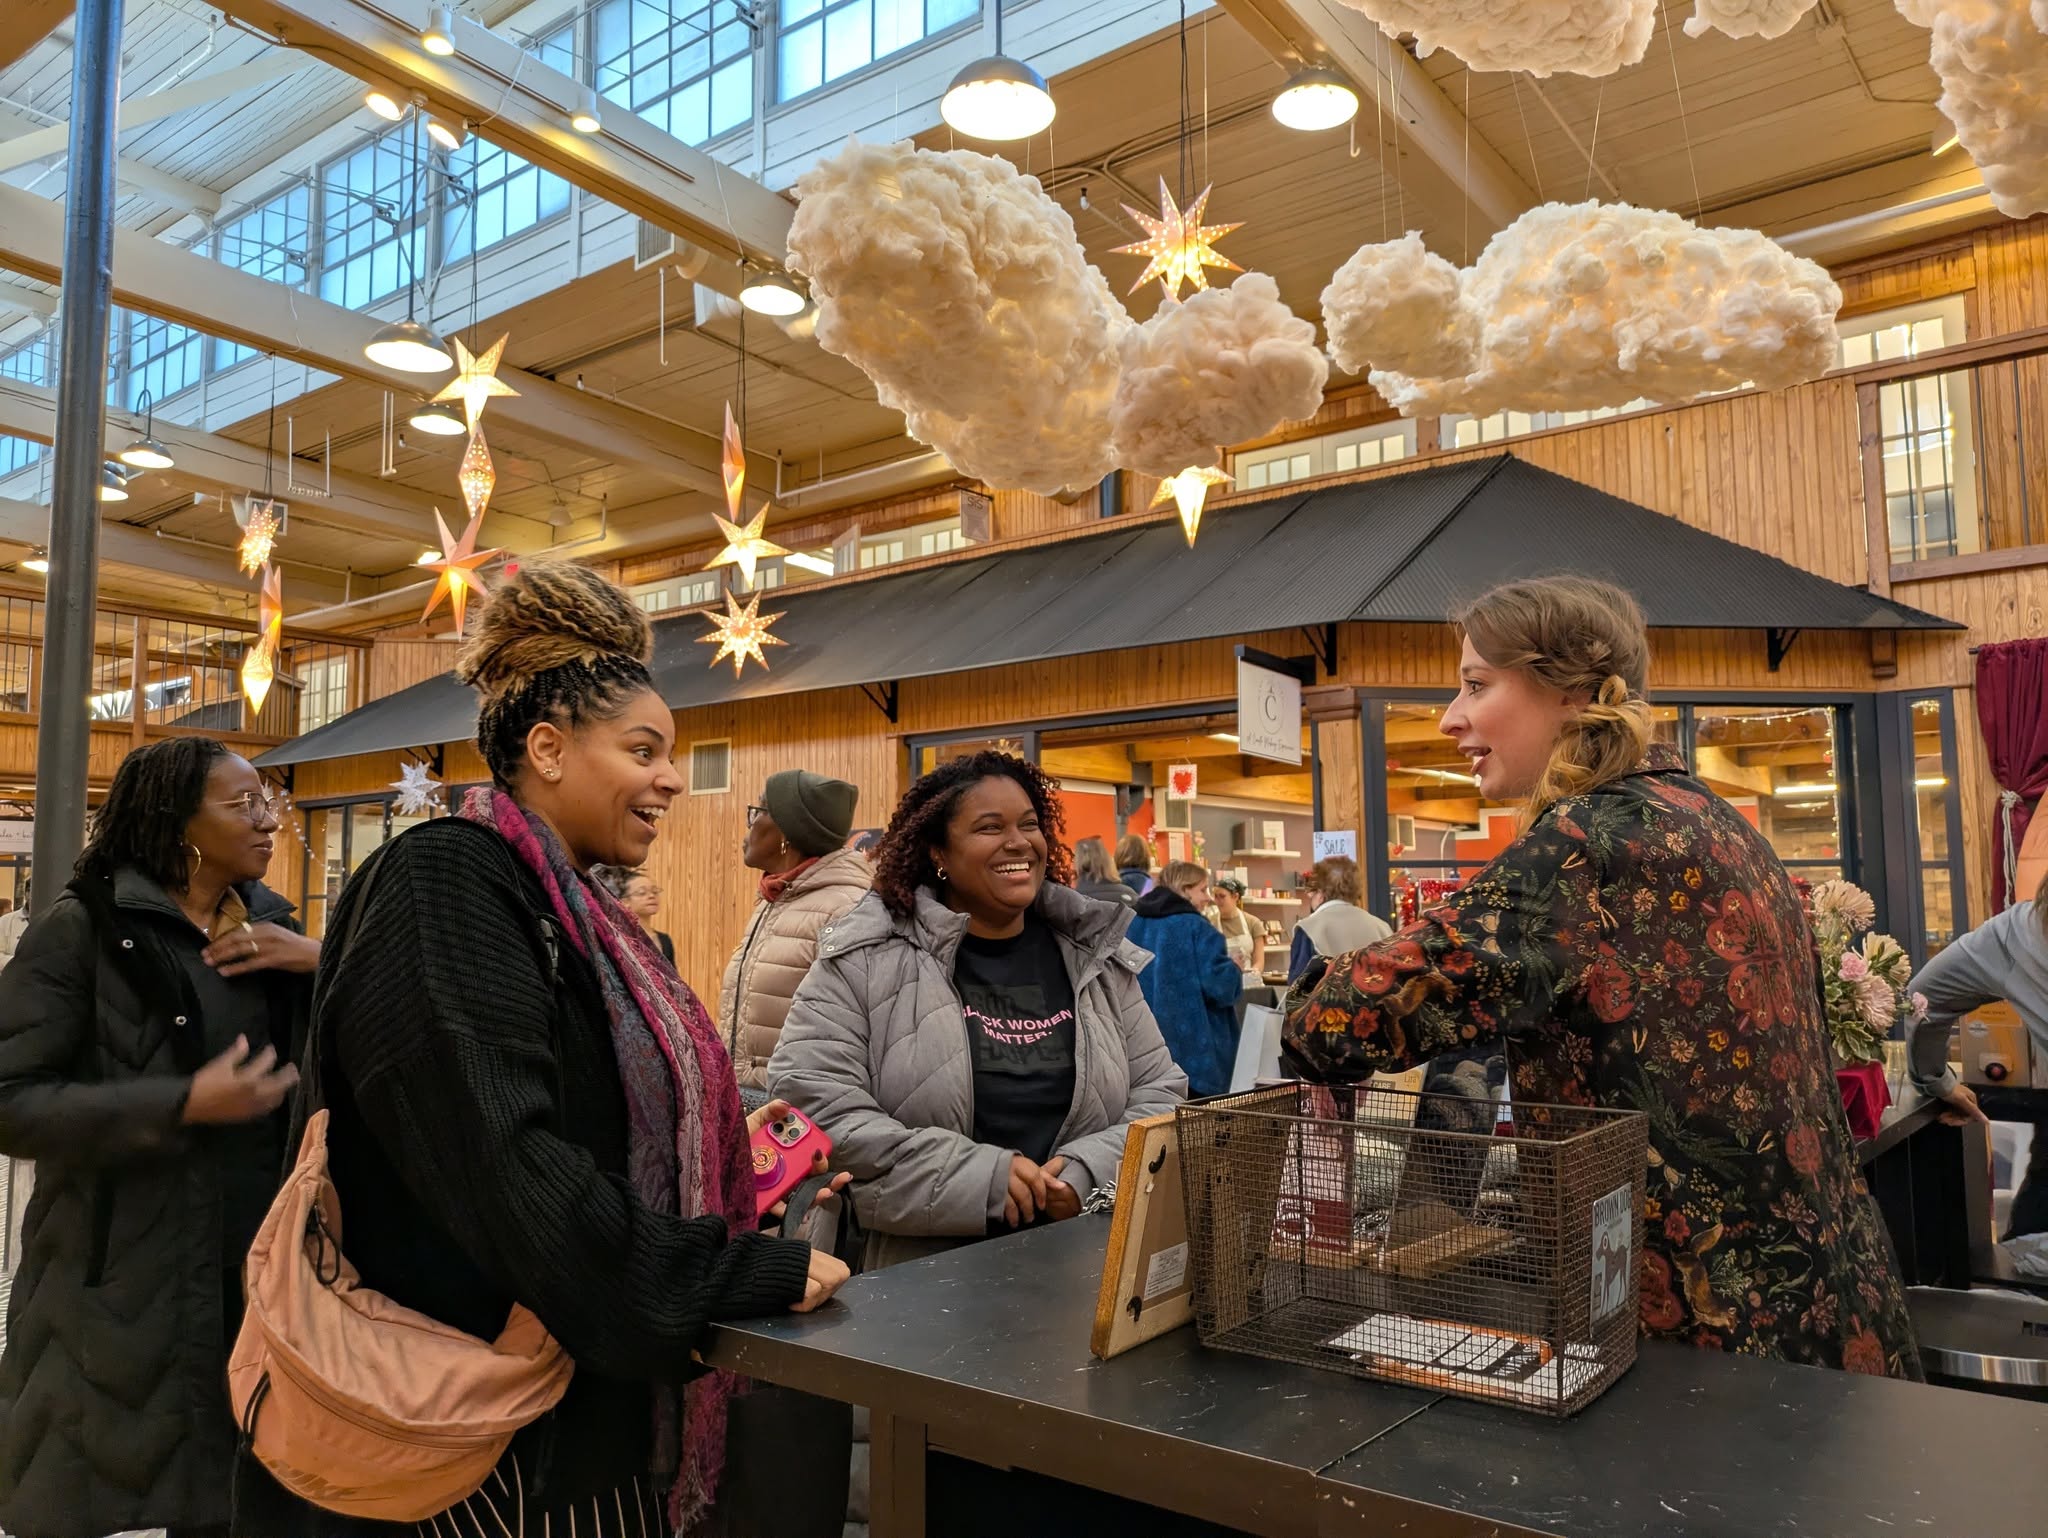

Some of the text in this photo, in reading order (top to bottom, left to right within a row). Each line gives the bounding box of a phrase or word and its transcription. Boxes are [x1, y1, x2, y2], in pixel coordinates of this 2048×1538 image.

[1264, 695, 1276, 721] C
[1323, 838, 1346, 855] SALE
[1006, 1009, 1074, 1030] WOMEN
[1593, 1192, 1619, 1228] BROWN
